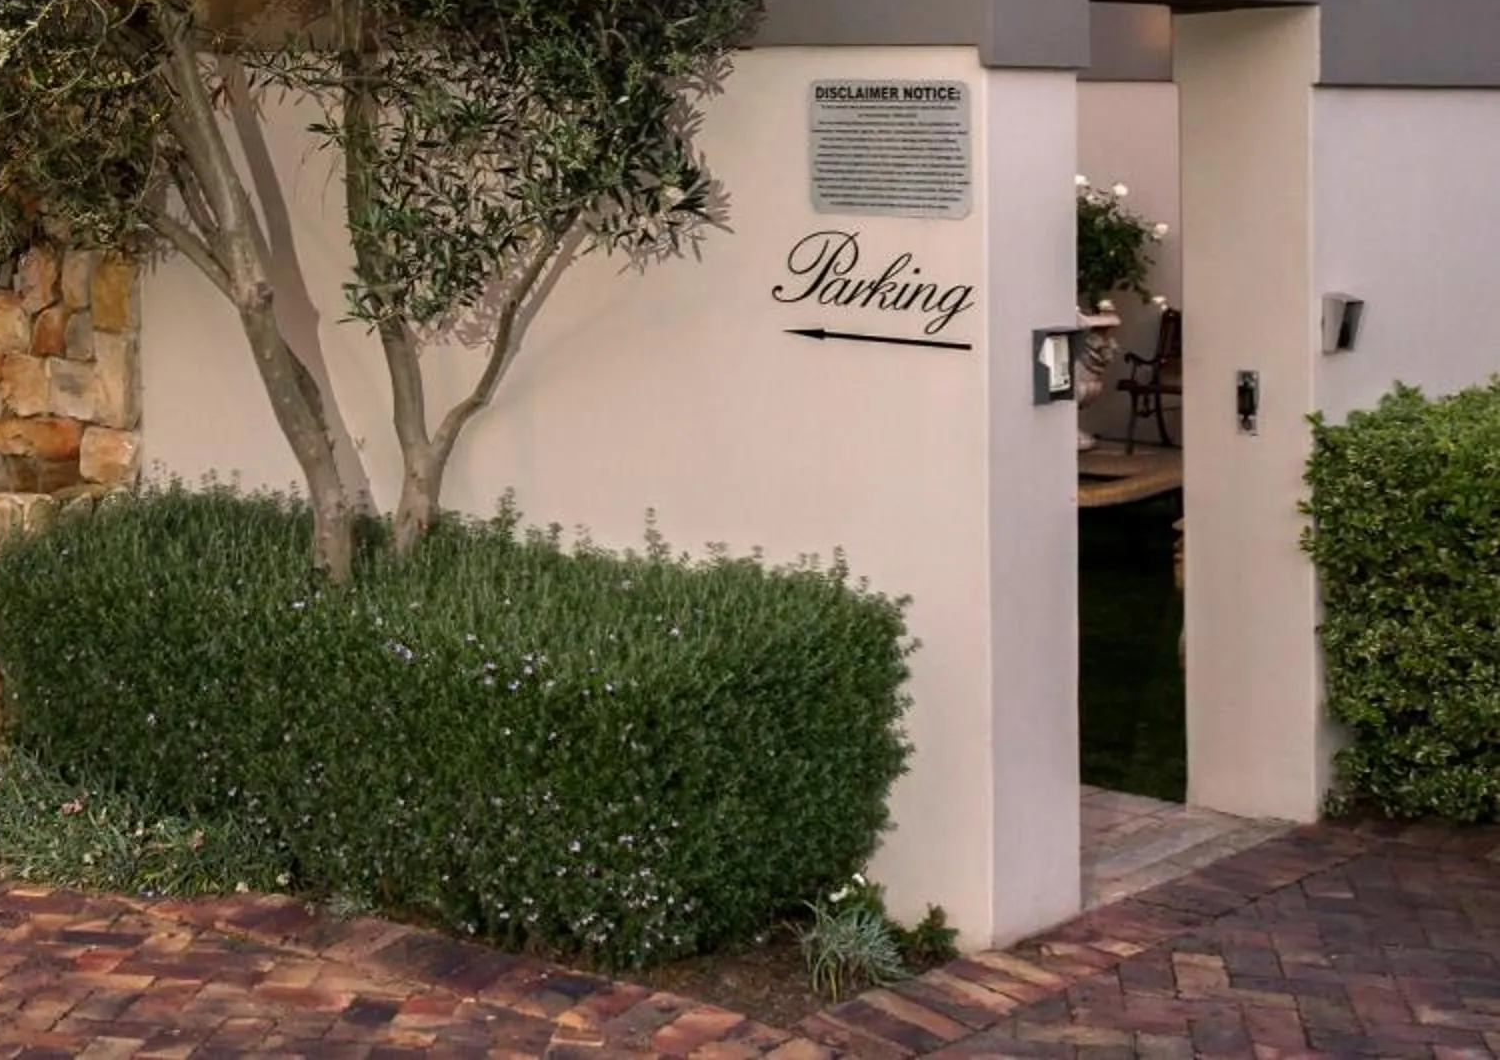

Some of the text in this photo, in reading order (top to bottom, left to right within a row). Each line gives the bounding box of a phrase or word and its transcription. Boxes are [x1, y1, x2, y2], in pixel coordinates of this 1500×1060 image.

[815, 86, 961, 101] DISCLAIMER NOTICE:
[771, 231, 976, 335] Parking
